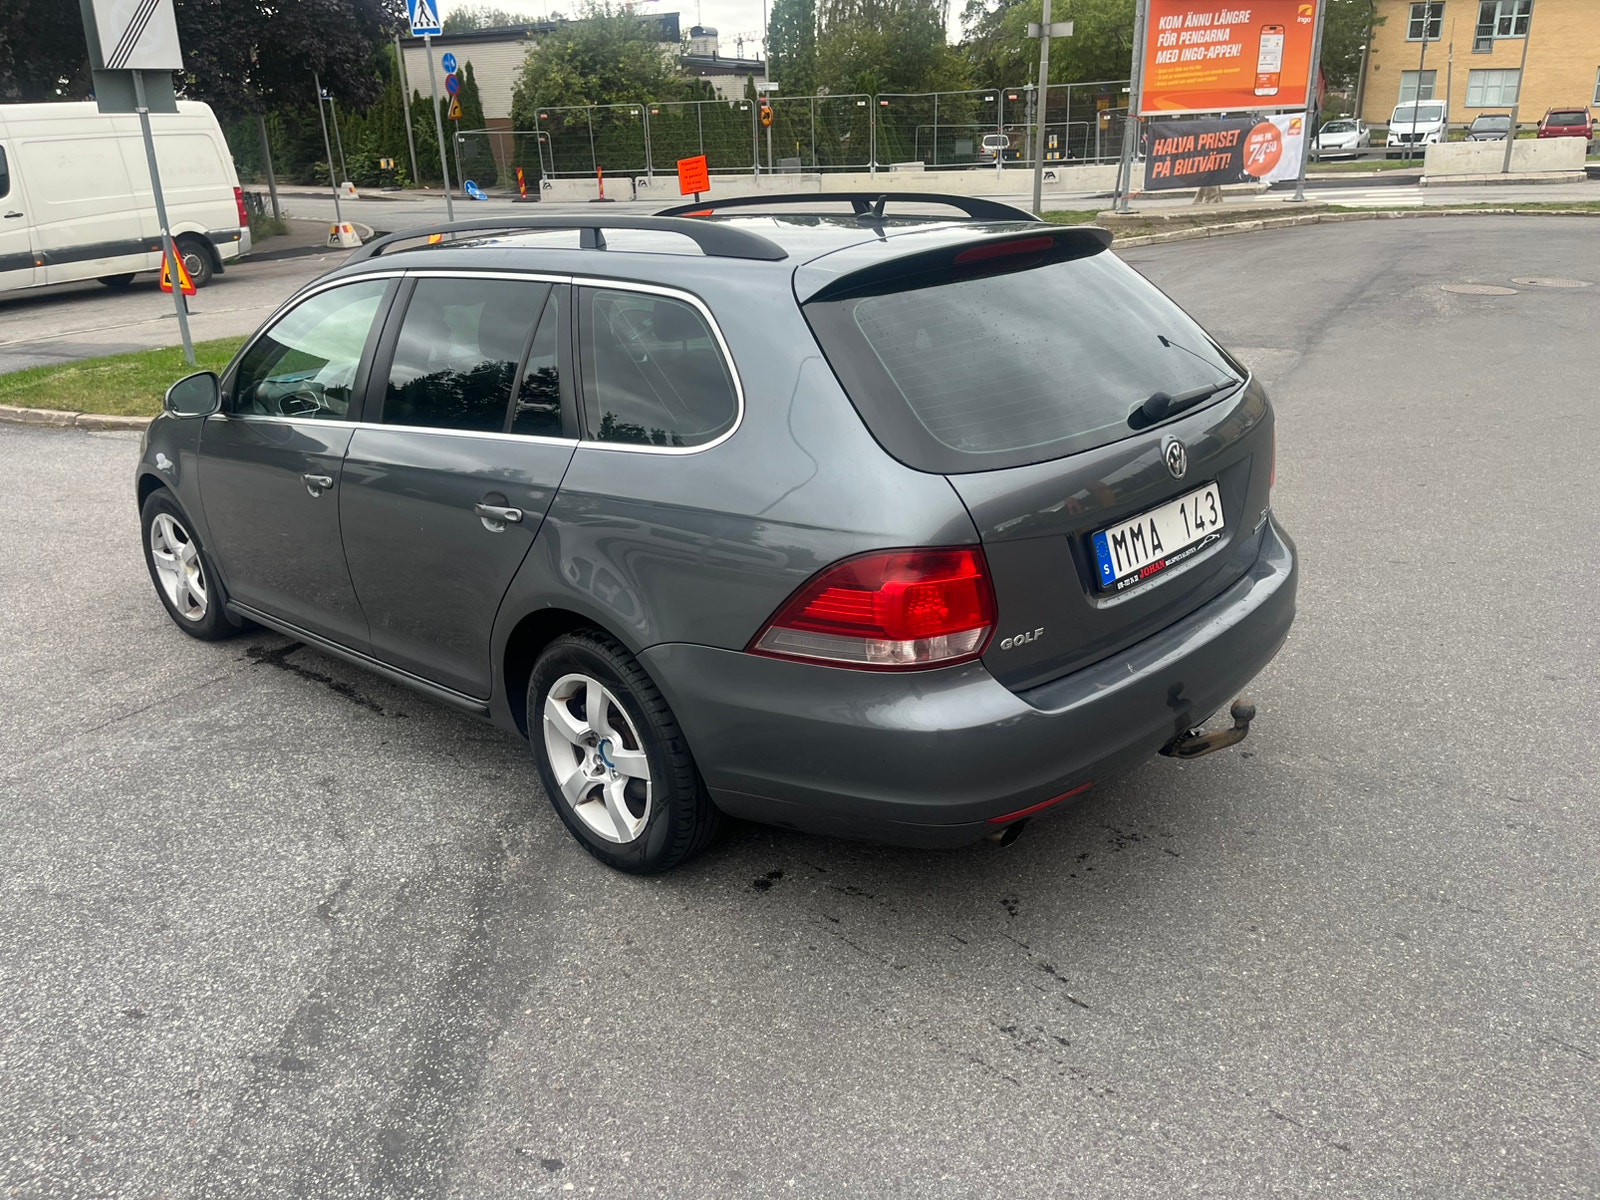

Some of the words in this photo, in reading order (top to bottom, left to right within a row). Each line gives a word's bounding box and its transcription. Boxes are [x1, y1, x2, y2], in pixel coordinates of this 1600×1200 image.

[1159, 15, 1183, 30] KOM
[1184, 12, 1212, 27] ÄNNU
[1214, 9, 1251, 25] LÄNGRE
[1157, 30, 1177, 47] FÖR
[1179, 28, 1230, 45] PENGARNA
[1155, 49, 1179, 64] MED
[1180, 44, 1242, 62] INGO-APPEN!
[1152, 133, 1195, 156] HALVA
[1197, 129, 1241, 151] PRISET
[1152, 155, 1171, 178] PÅ
[1173, 152, 1232, 176] BILTVÄTT!
[1111, 518, 1164, 572] MMA
[1180, 491, 1218, 539] 143
[1103, 564, 1110, 575] S
[1139, 559, 1166, 579] JOHAN
[1000, 627, 1044, 650] GOLF
